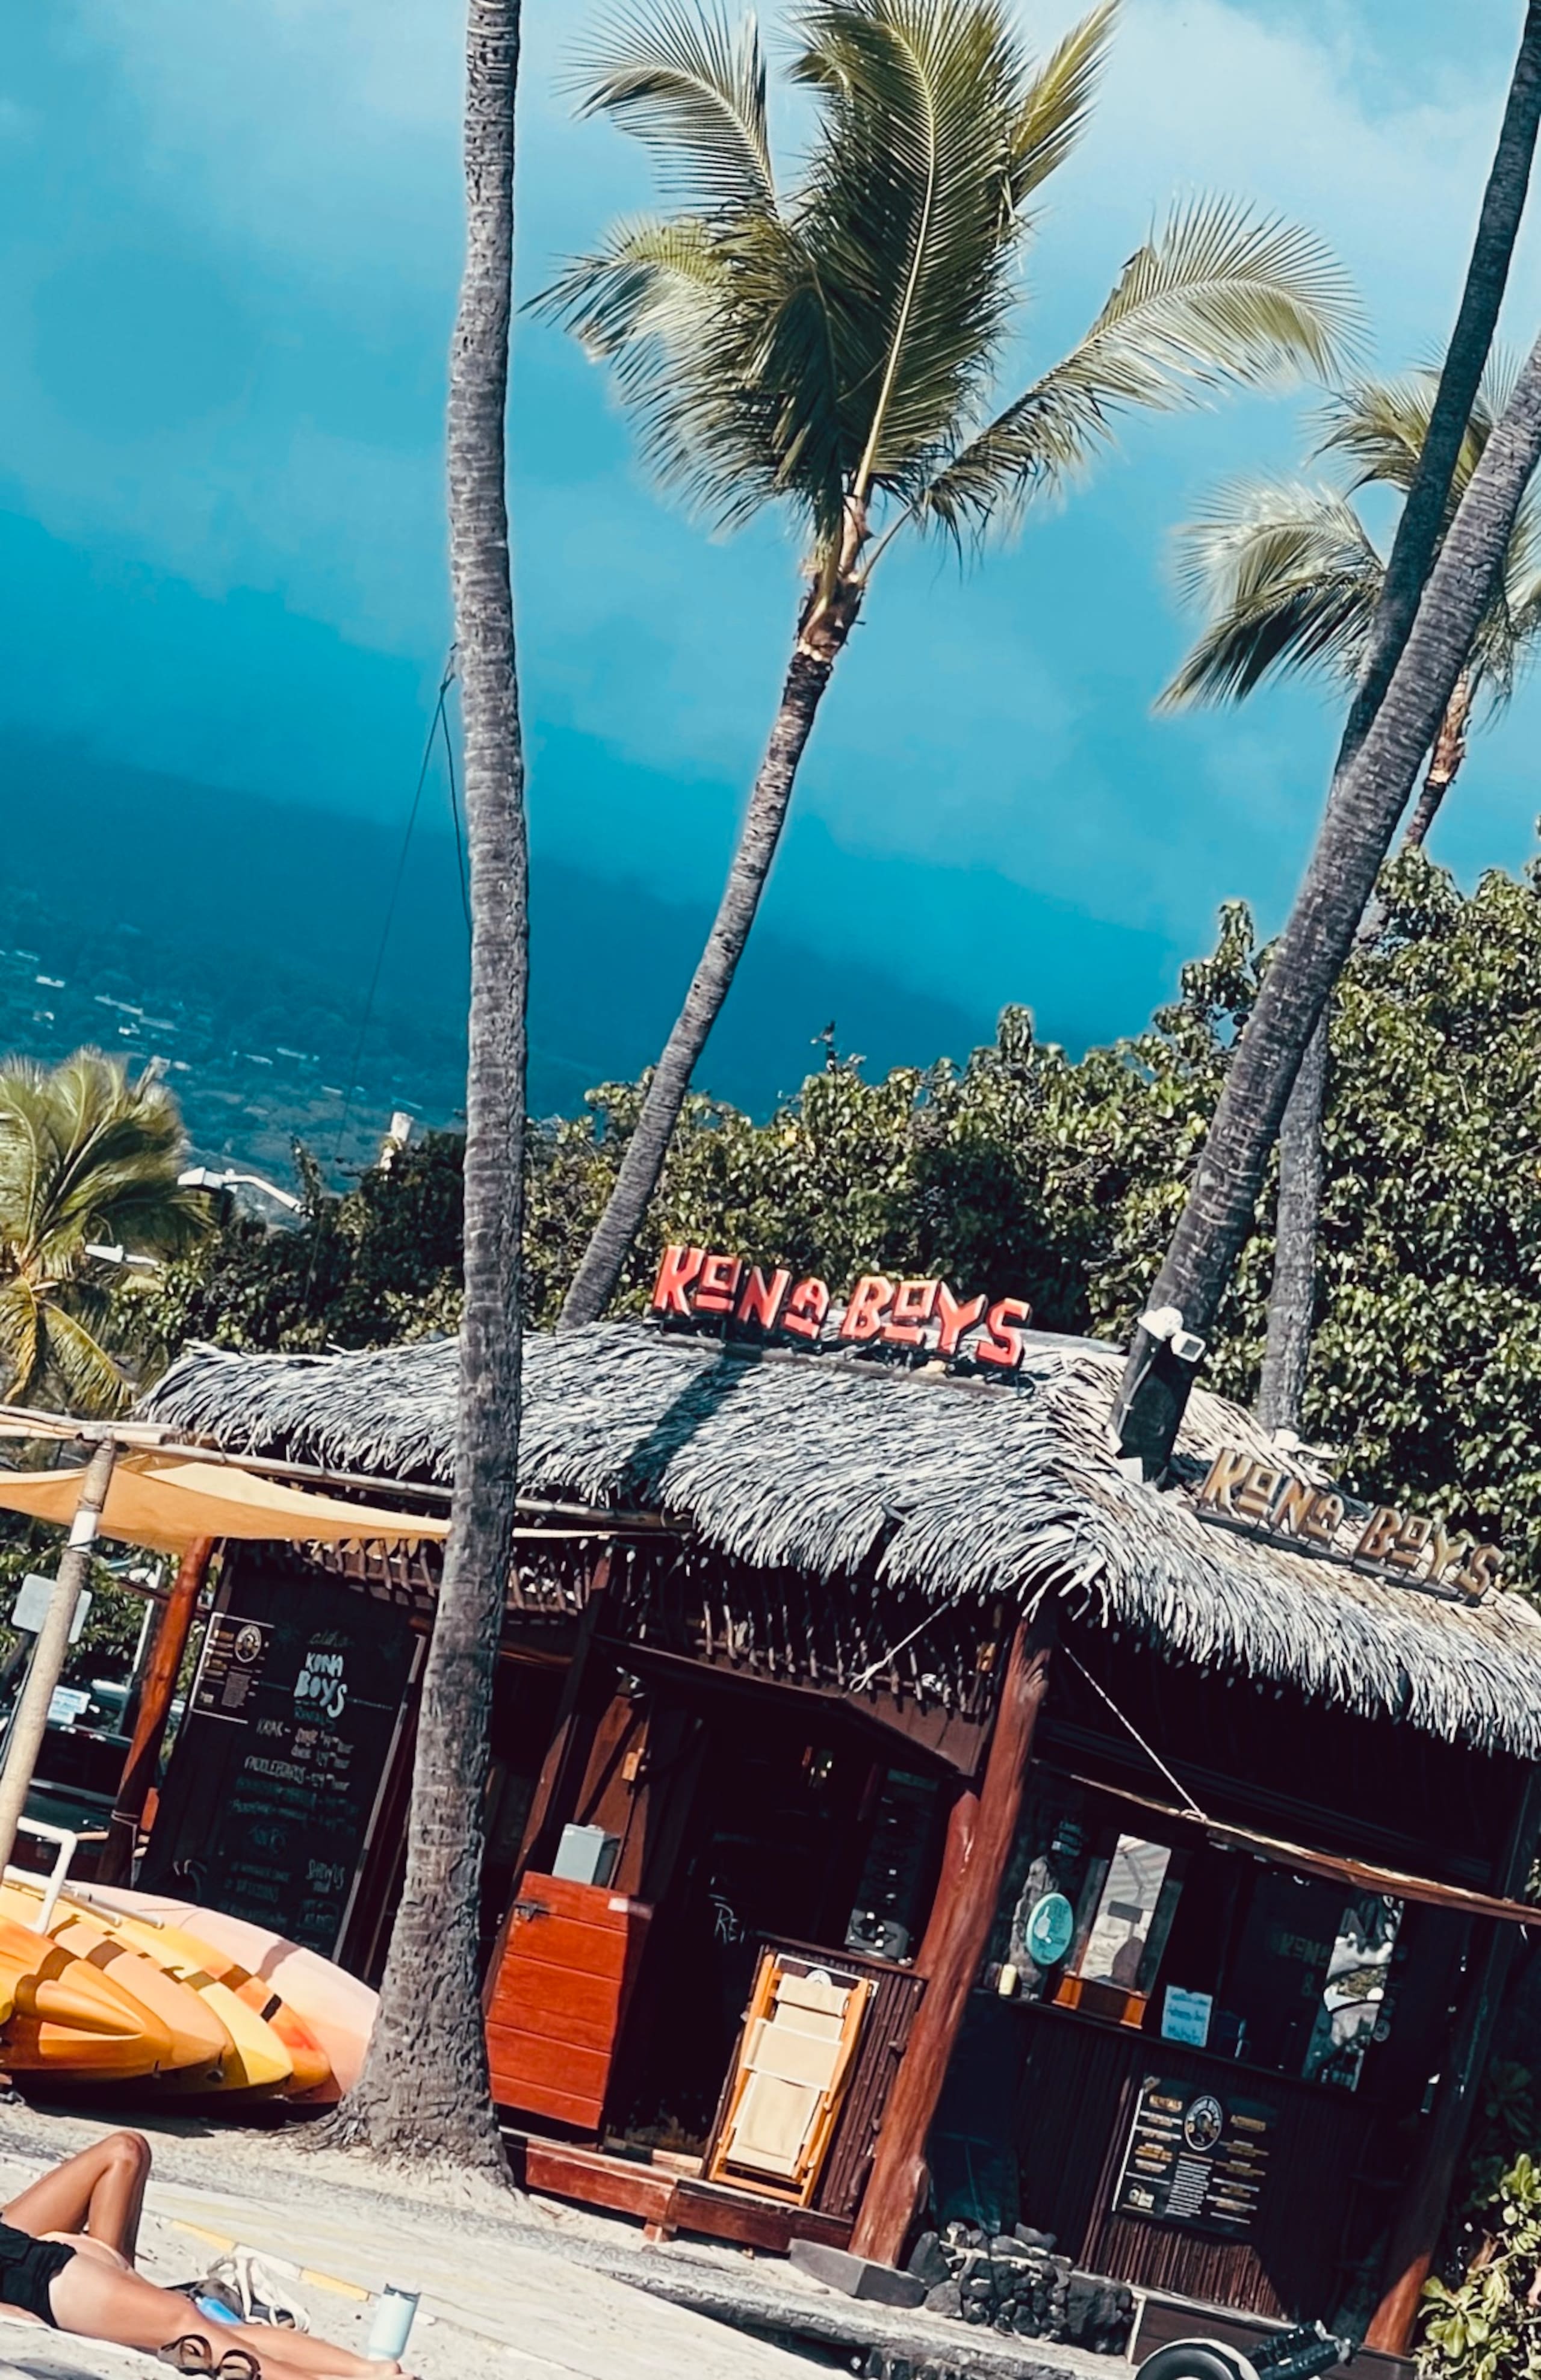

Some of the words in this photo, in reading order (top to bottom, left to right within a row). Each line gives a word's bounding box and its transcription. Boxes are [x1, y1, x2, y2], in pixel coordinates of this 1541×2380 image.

[653, 1245, 830, 1340] KONA
[839, 1275, 1032, 1368] BOYS
[1201, 1447, 1345, 1548] KONA
[1354, 1506, 1505, 1599] BOYS
[294, 1669, 348, 1718] BOYS
[305, 1652, 344, 1678] KONA
